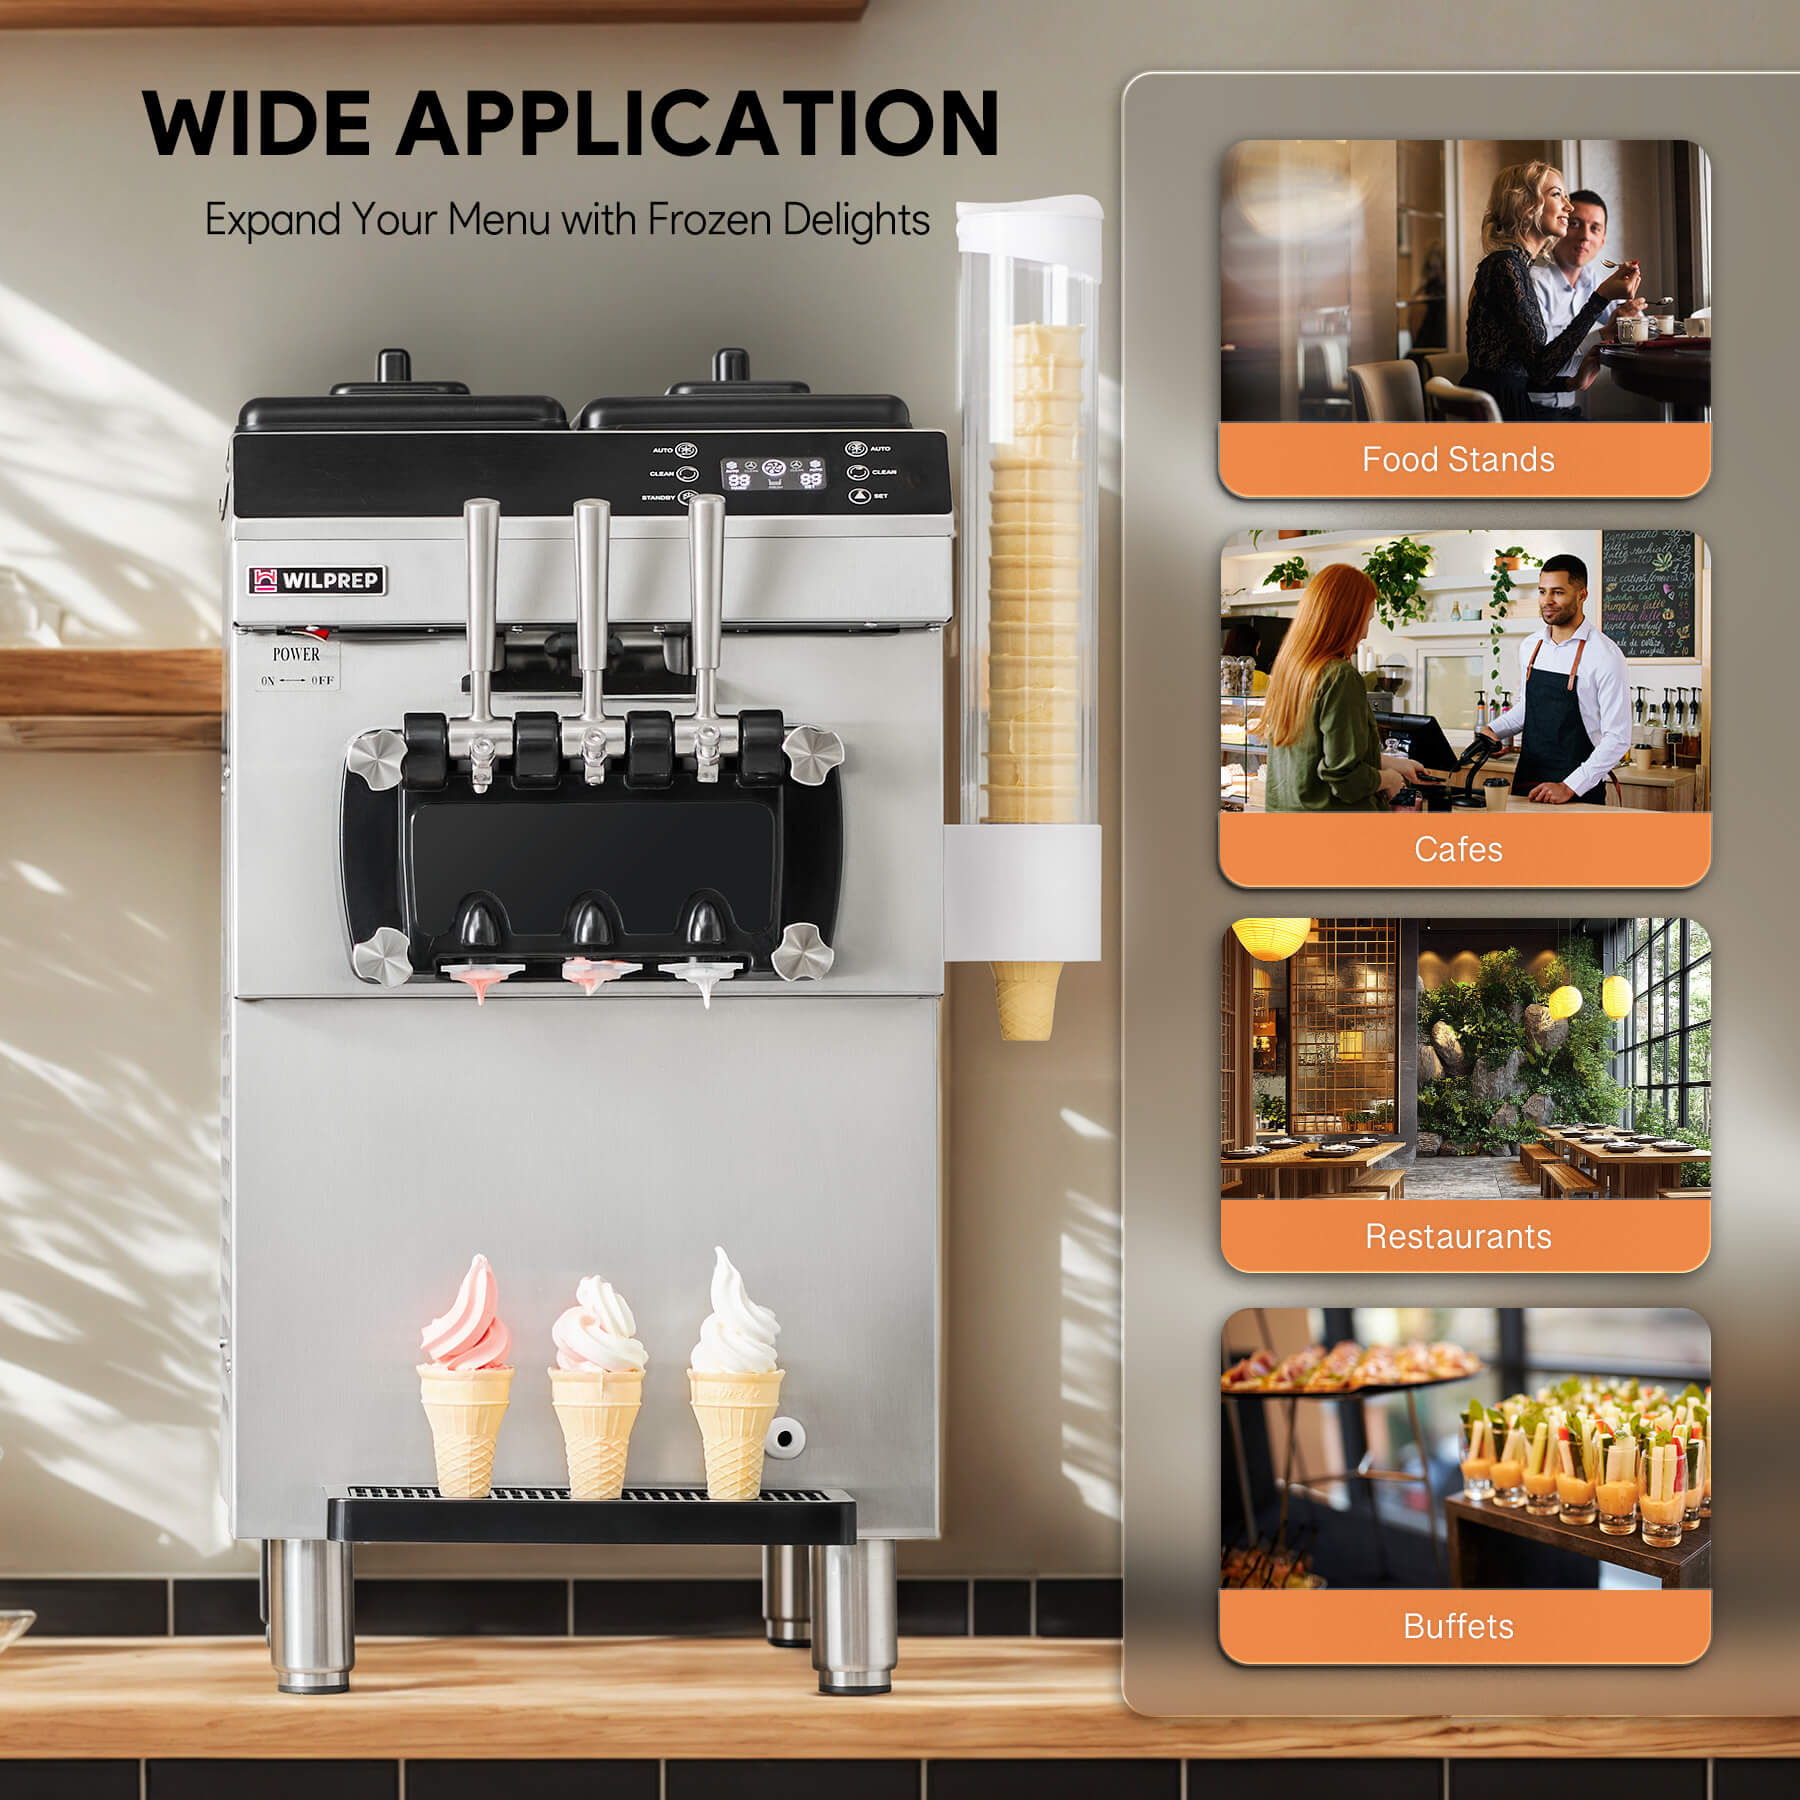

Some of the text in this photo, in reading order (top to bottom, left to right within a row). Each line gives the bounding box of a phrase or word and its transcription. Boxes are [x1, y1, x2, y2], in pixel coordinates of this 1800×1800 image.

[282, 572, 379, 589] WILPREP
[272, 647, 321, 662] POWER
[261, 675, 335, 686] ON OFF
